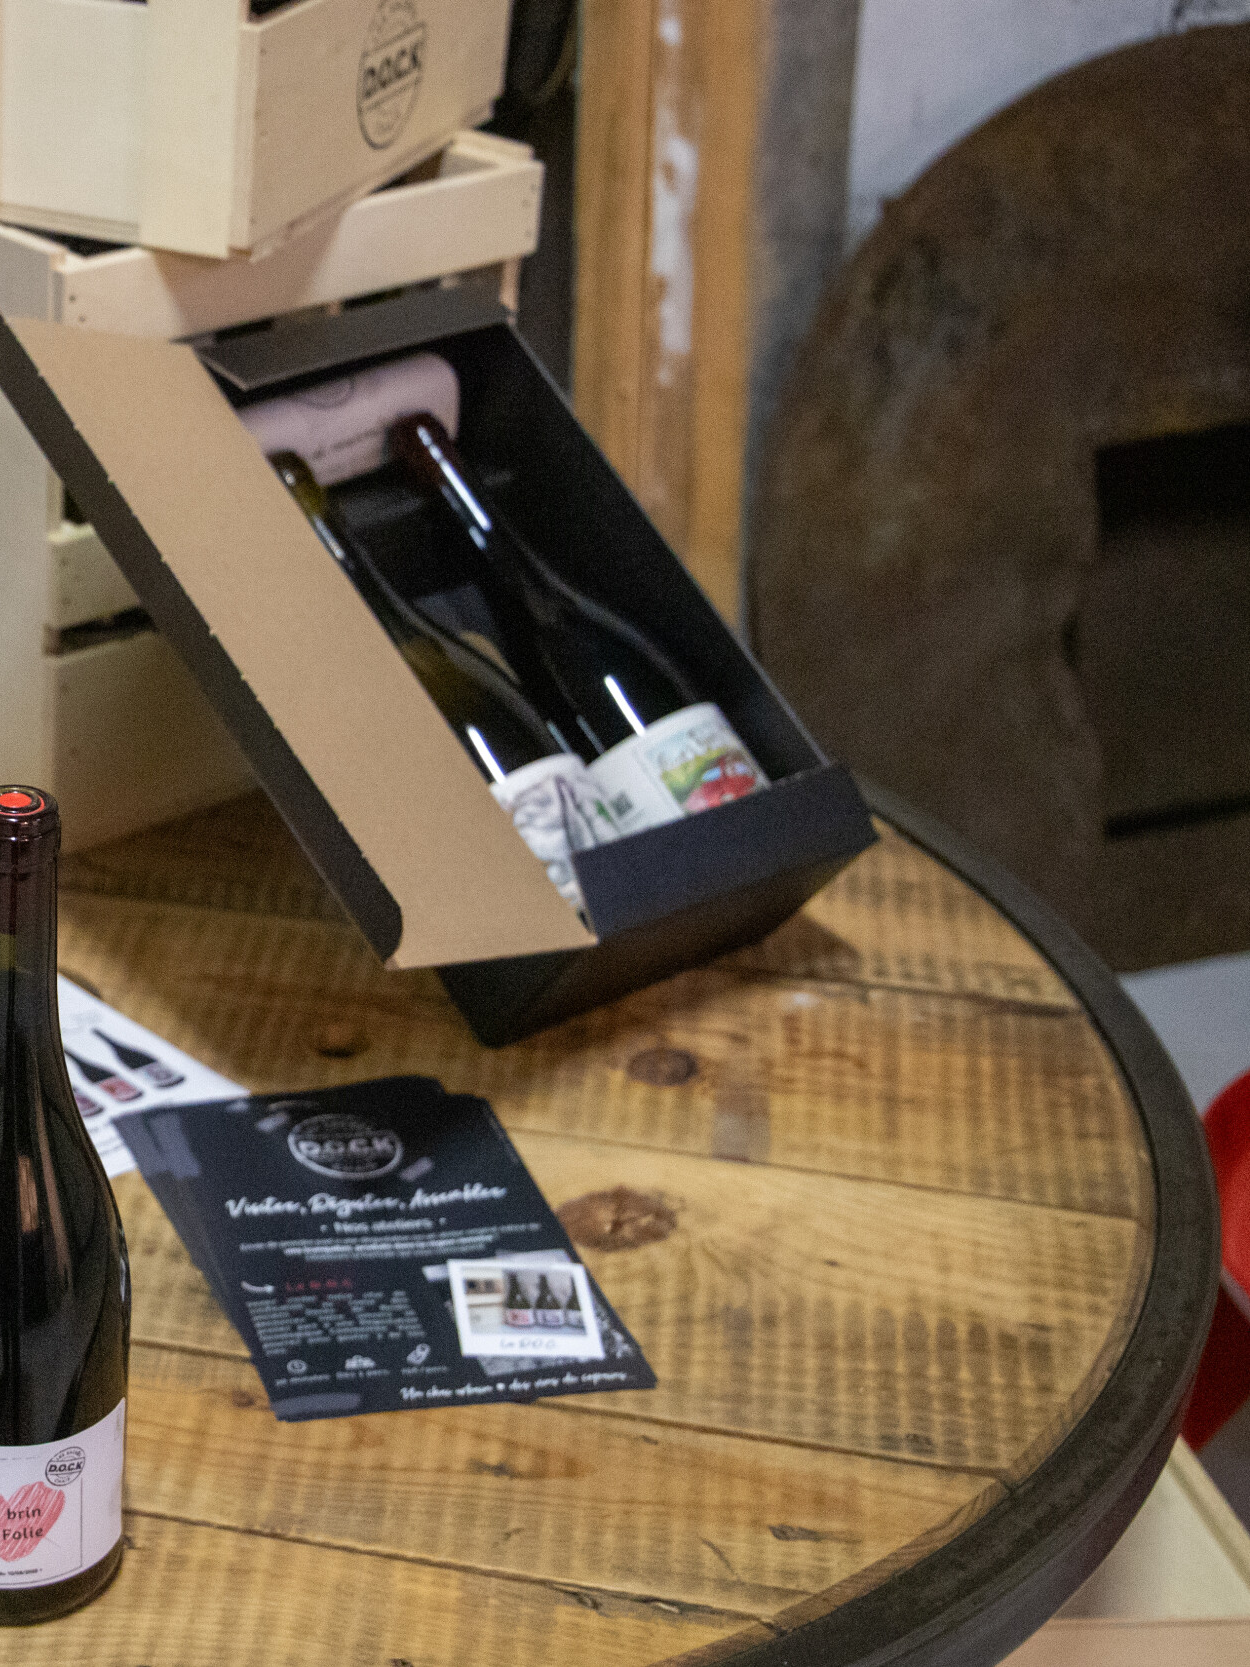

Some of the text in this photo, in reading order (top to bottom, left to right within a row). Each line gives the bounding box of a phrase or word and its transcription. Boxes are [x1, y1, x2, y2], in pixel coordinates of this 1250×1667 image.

[48, 1461, 83, 1473] D.O.C.K
[7, 1506, 42, 1520] brin
[3, 1527, 44, 1541] Folie
